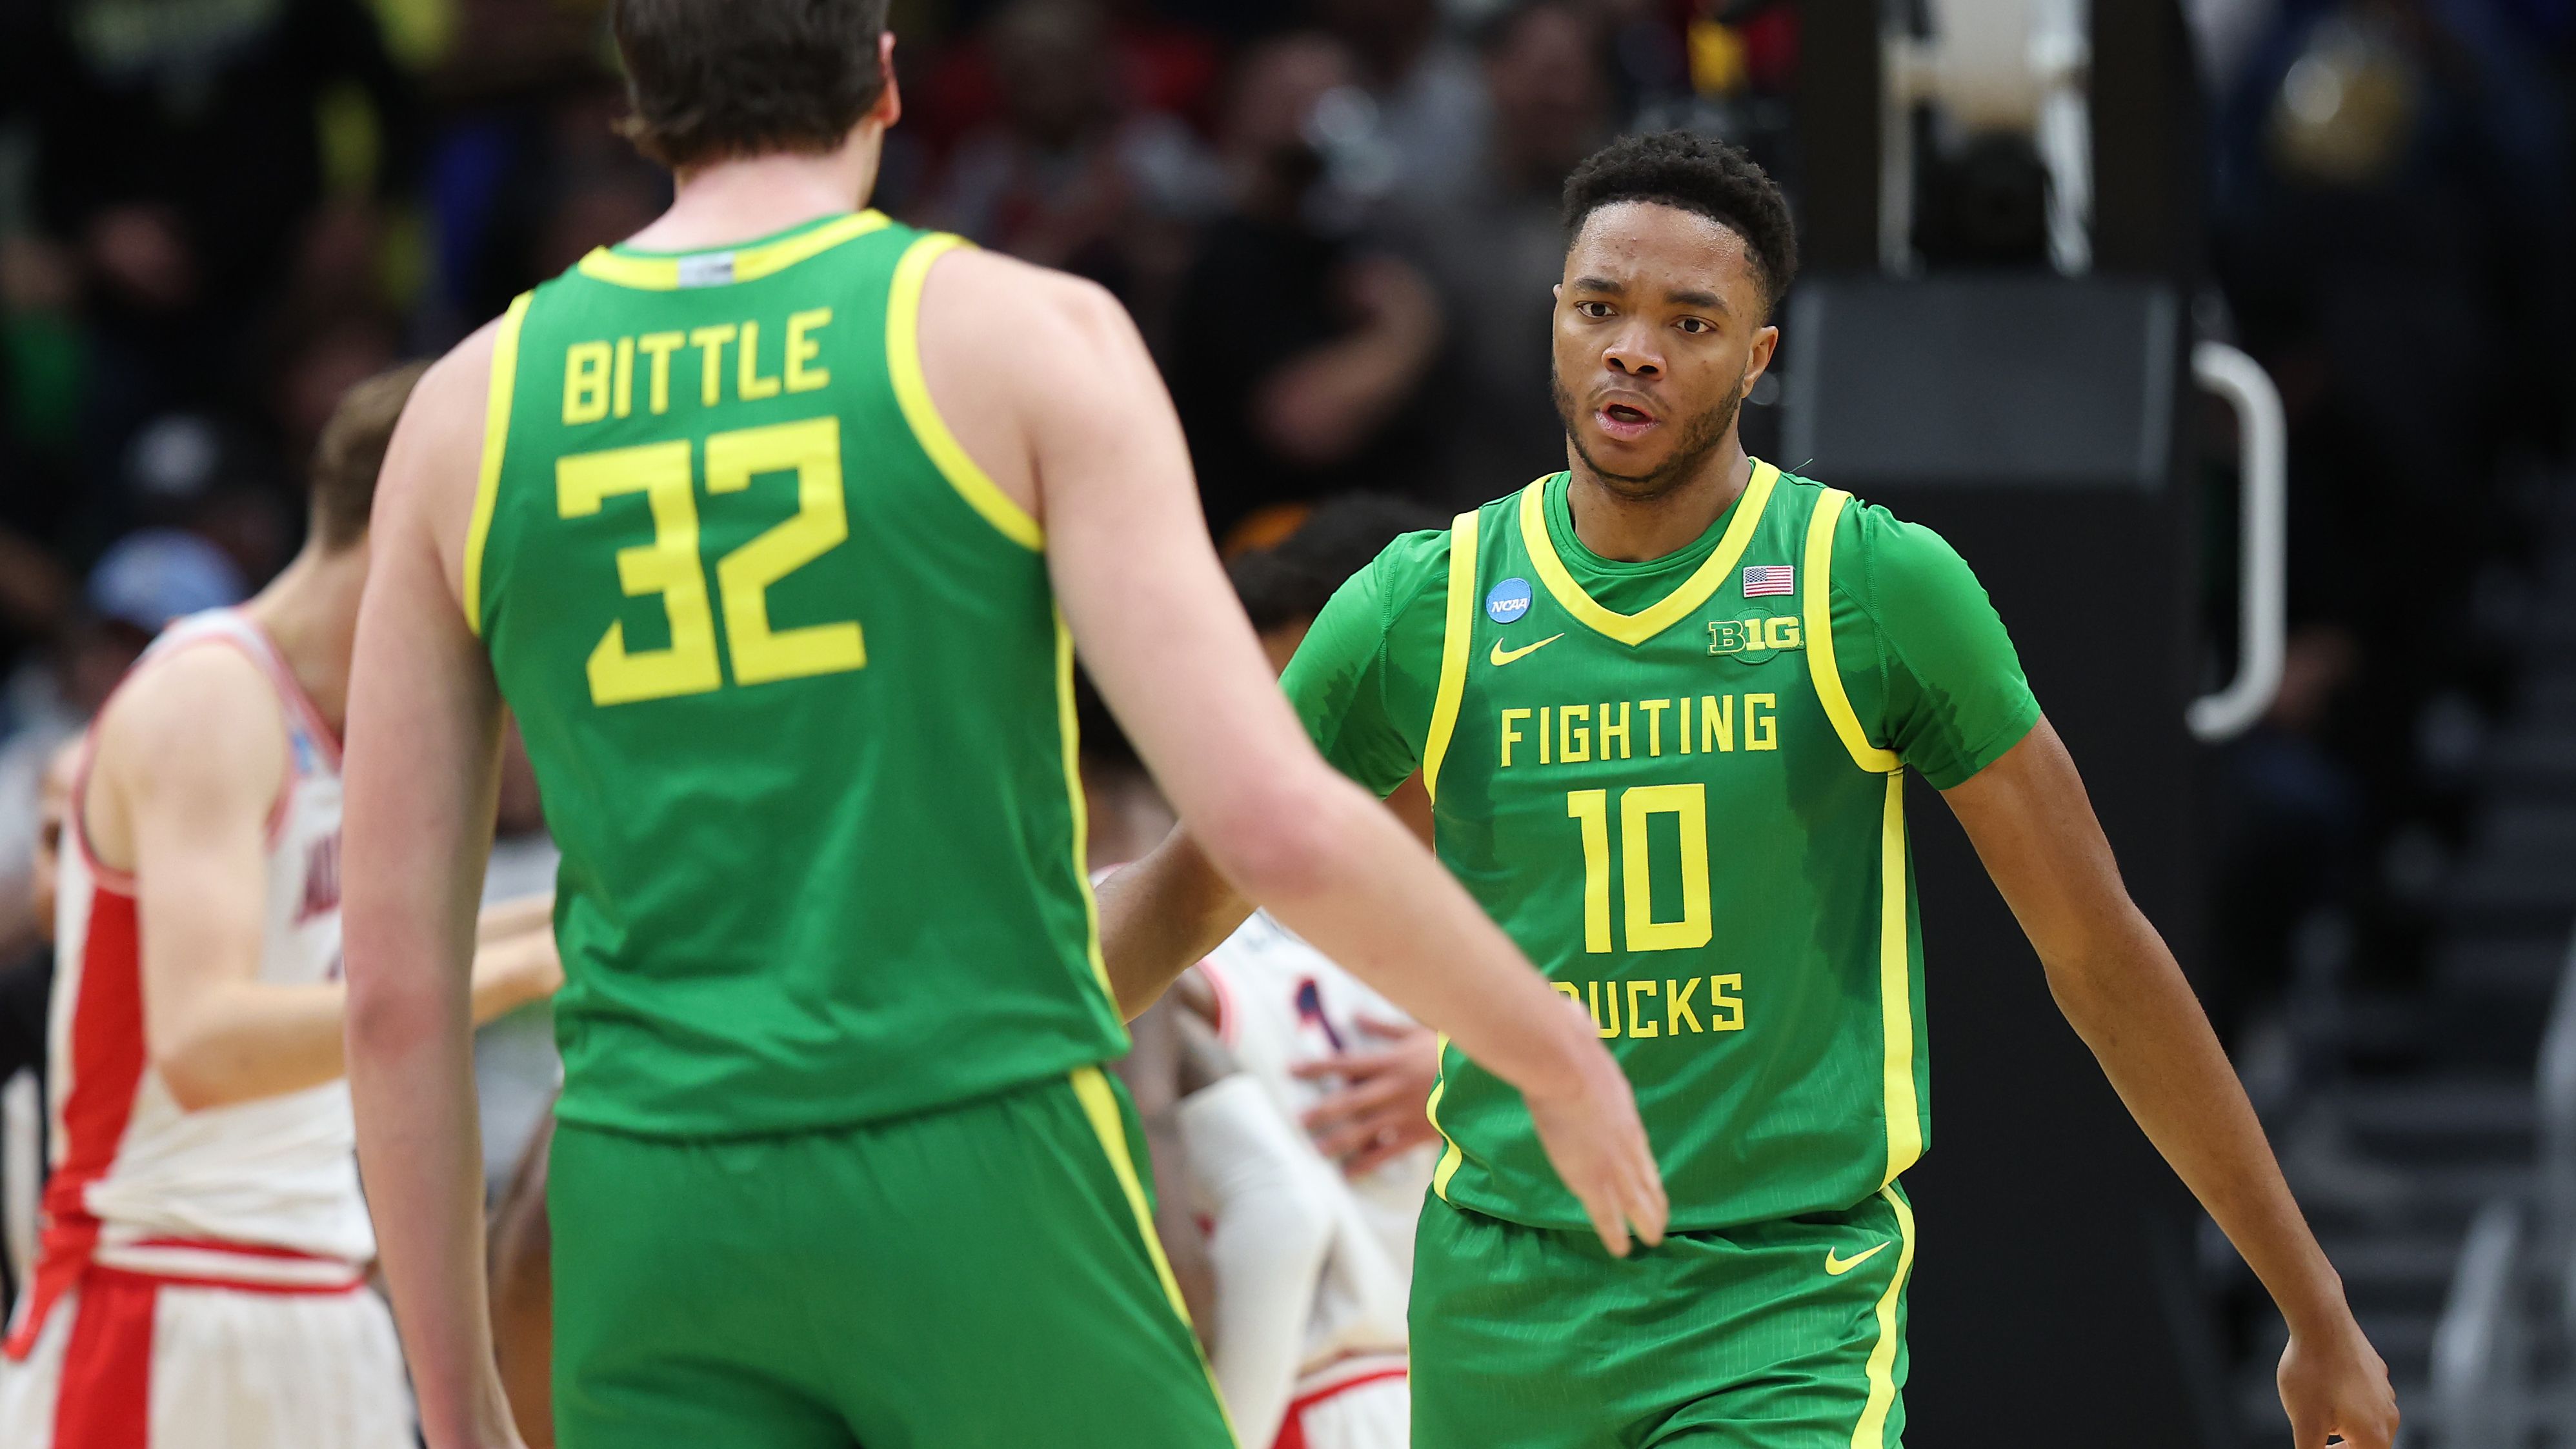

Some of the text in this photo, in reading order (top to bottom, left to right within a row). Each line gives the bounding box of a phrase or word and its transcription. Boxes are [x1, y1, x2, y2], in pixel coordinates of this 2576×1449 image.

[562, 307, 832, 426] BITTLE
[556, 415, 867, 708] 32
[1491, 597, 1528, 613] NCAA
[1501, 693, 1777, 767] FIGHTING
[1567, 783, 1713, 954] 10
